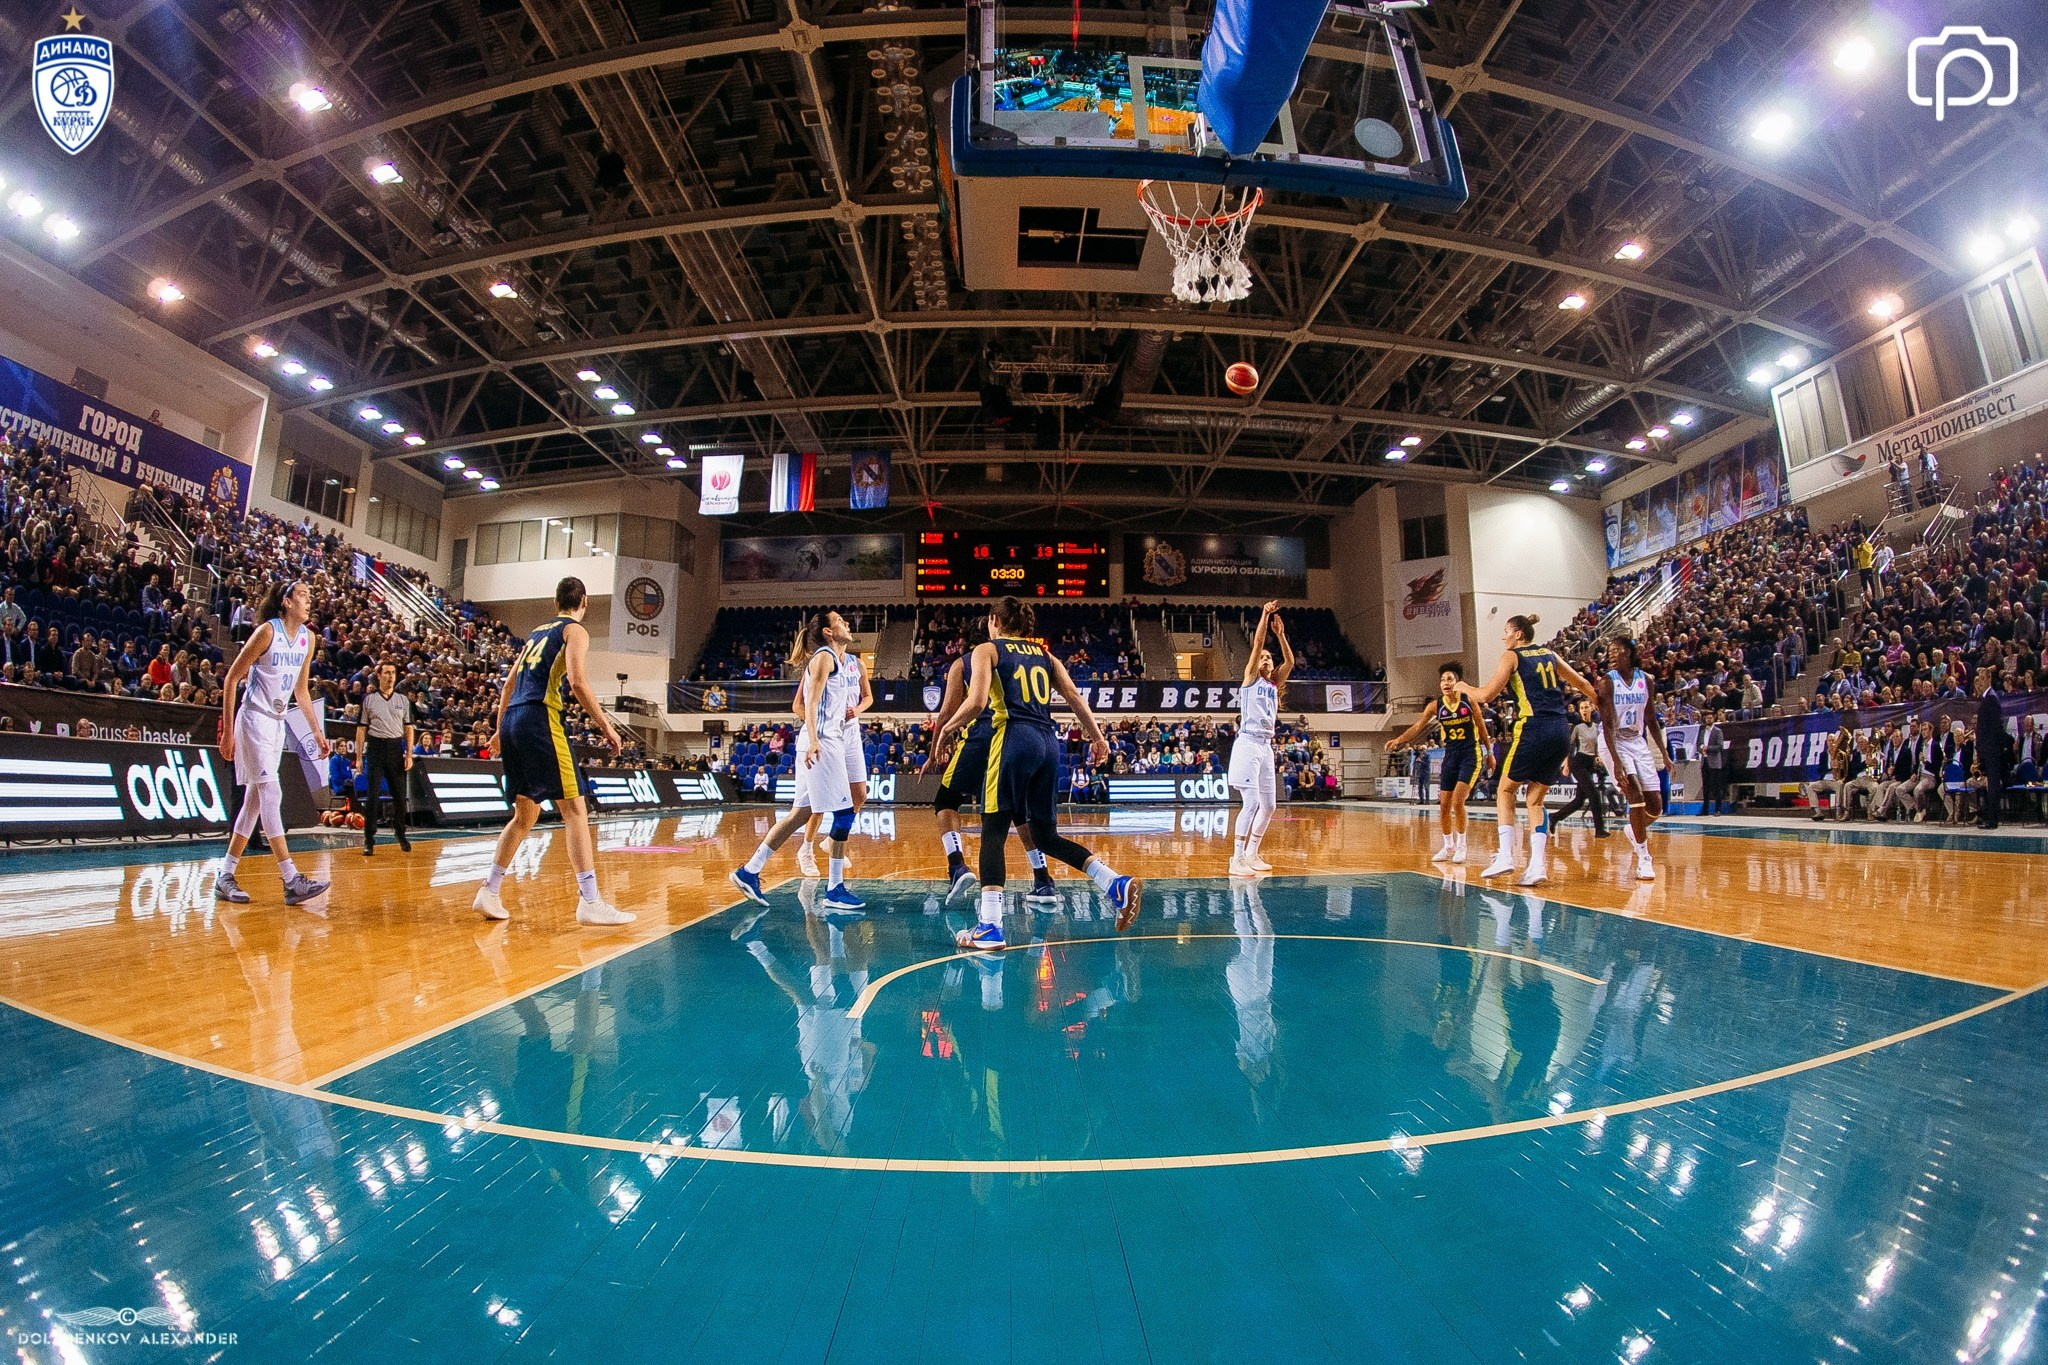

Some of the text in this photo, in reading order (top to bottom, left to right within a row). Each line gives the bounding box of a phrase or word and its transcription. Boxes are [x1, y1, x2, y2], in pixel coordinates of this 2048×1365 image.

[79, 405, 143, 455] ГОРОД
[1876, 393, 2016, 463] Металлоинвест
[0, 405, 117, 468] СТРЕМЛЕННЫЙ
[121, 455, 132, 474] В
[991, 568, 1025, 579] 03:30
[1191, 565, 1285, 576] КУРСКОЙ ОБЛАСТИ
[627, 622, 659, 637] РФБ
[1005, 643, 1044, 656] PLUM
[1013, 664, 1050, 704] 10
[1536, 661, 1557, 689] 11
[1626, 711, 1637, 725] 31
[711, 735, 719, 746] F
[1331, 735, 1339, 746] F
[1449, 728, 1466, 740] 32
[127, 749, 228, 823] adid
[866, 774, 895, 801] did
[1180, 773, 1229, 800] adid
